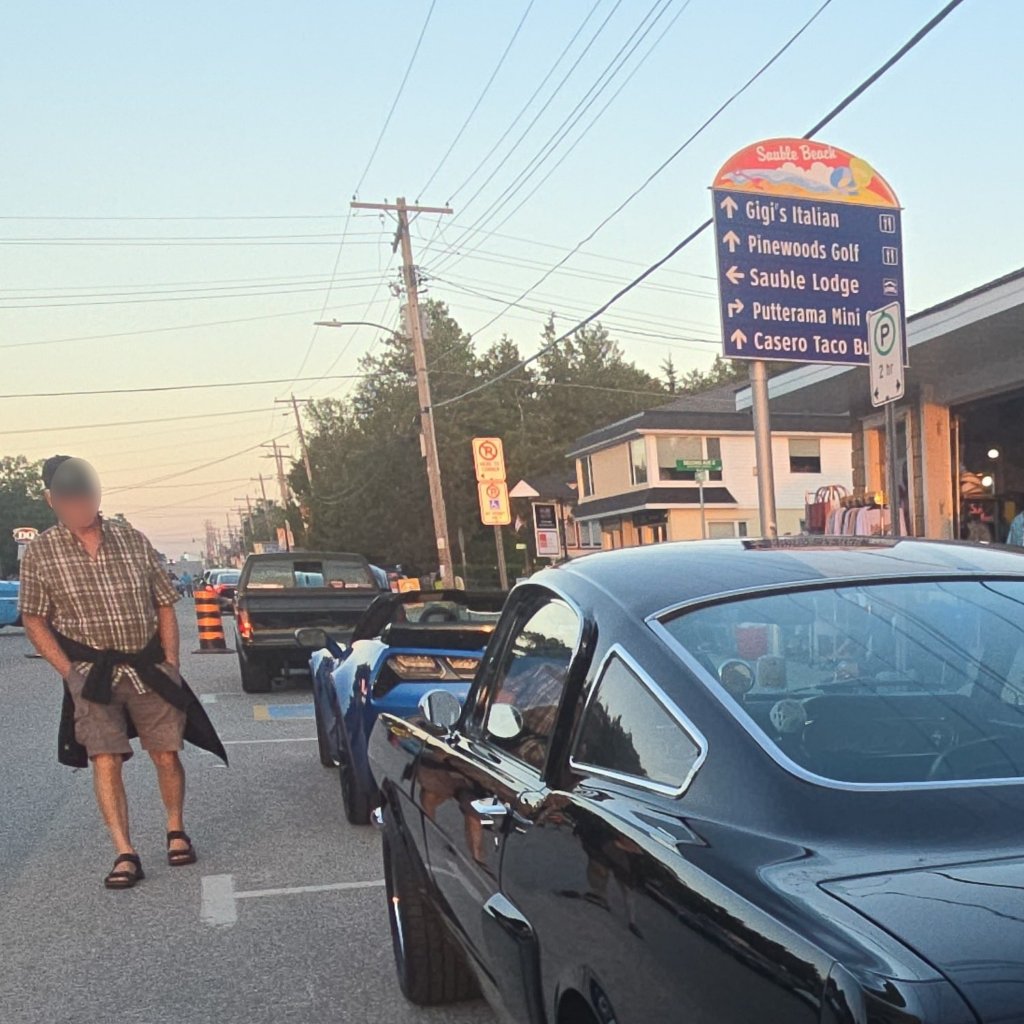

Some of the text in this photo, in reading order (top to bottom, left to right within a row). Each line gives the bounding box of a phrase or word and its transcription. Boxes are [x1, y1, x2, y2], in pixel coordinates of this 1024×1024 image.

[756, 144, 837, 162] Sauble Beach
[746, 200, 840, 228] Gigi's Italian
[748, 234, 860, 262] Pinewoods Golf
[750, 268, 860, 298] Sauble Lodge
[752, 301, 827, 324] Putterama
[832, 307, 861, 326] Mini
[754, 332, 808, 352] Casero
[813, 335, 848, 355] Taco
